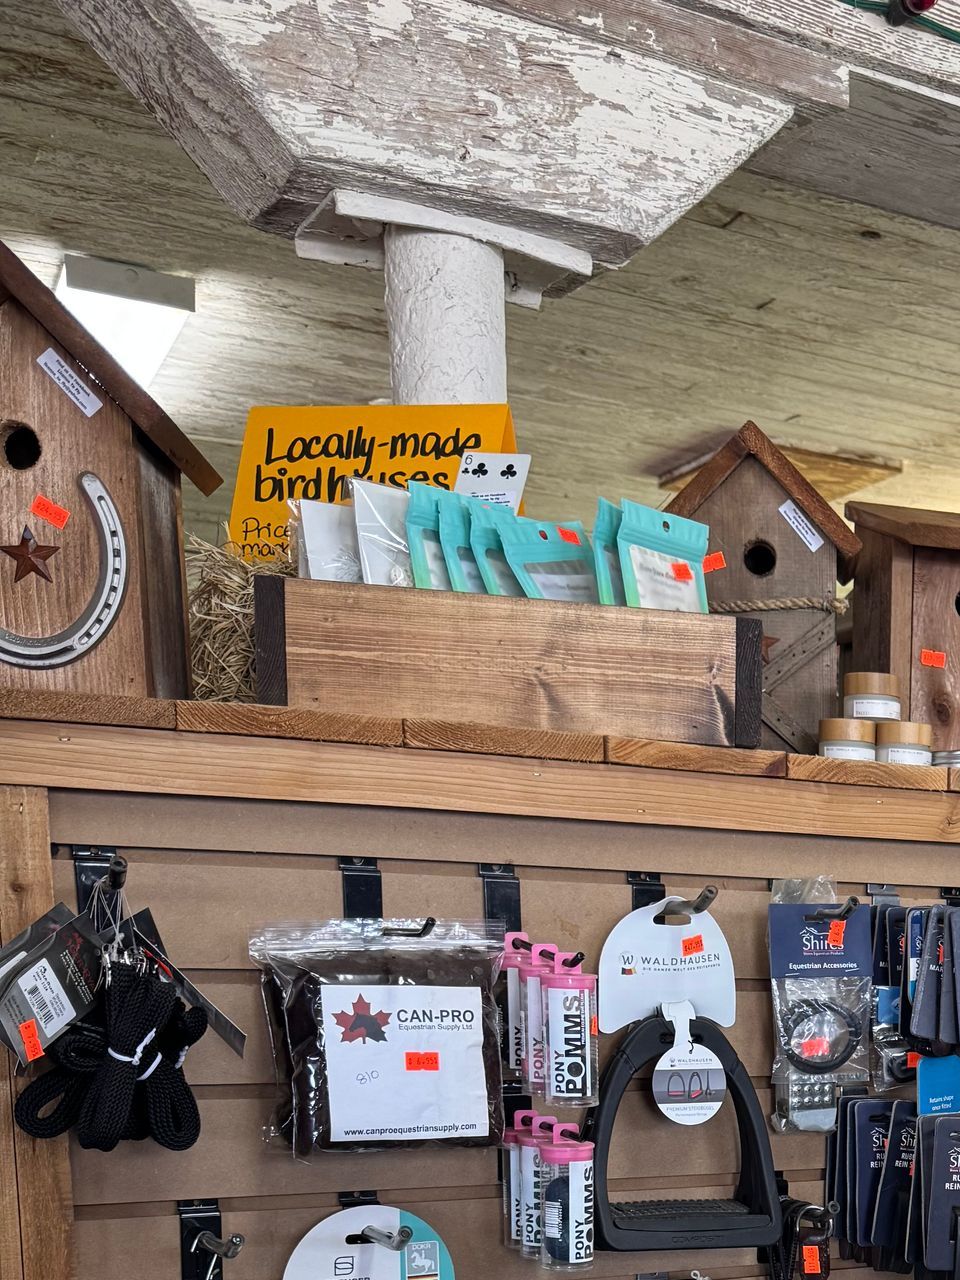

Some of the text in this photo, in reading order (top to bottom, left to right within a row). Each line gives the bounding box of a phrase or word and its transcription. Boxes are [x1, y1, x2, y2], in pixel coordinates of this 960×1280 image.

[265, 426, 481, 475] Locally-made
[464, 454, 473, 465] 6
[641, 953, 720, 966] WALDHAUSEN
[789, 962, 821, 970] Equestrian
[397, 1009, 474, 1022] CAN-PRO
[533, 1038, 544, 1080] PONY
[563, 995, 582, 1097] POMMS
[356, 1071, 380, 1084] 810
[555, 1051, 565, 1093] PONY
[344, 1123, 477, 1136] www.canproequestriansupply.com
[525, 1203, 534, 1243] PONY
[575, 1220, 584, 1260] PONY
